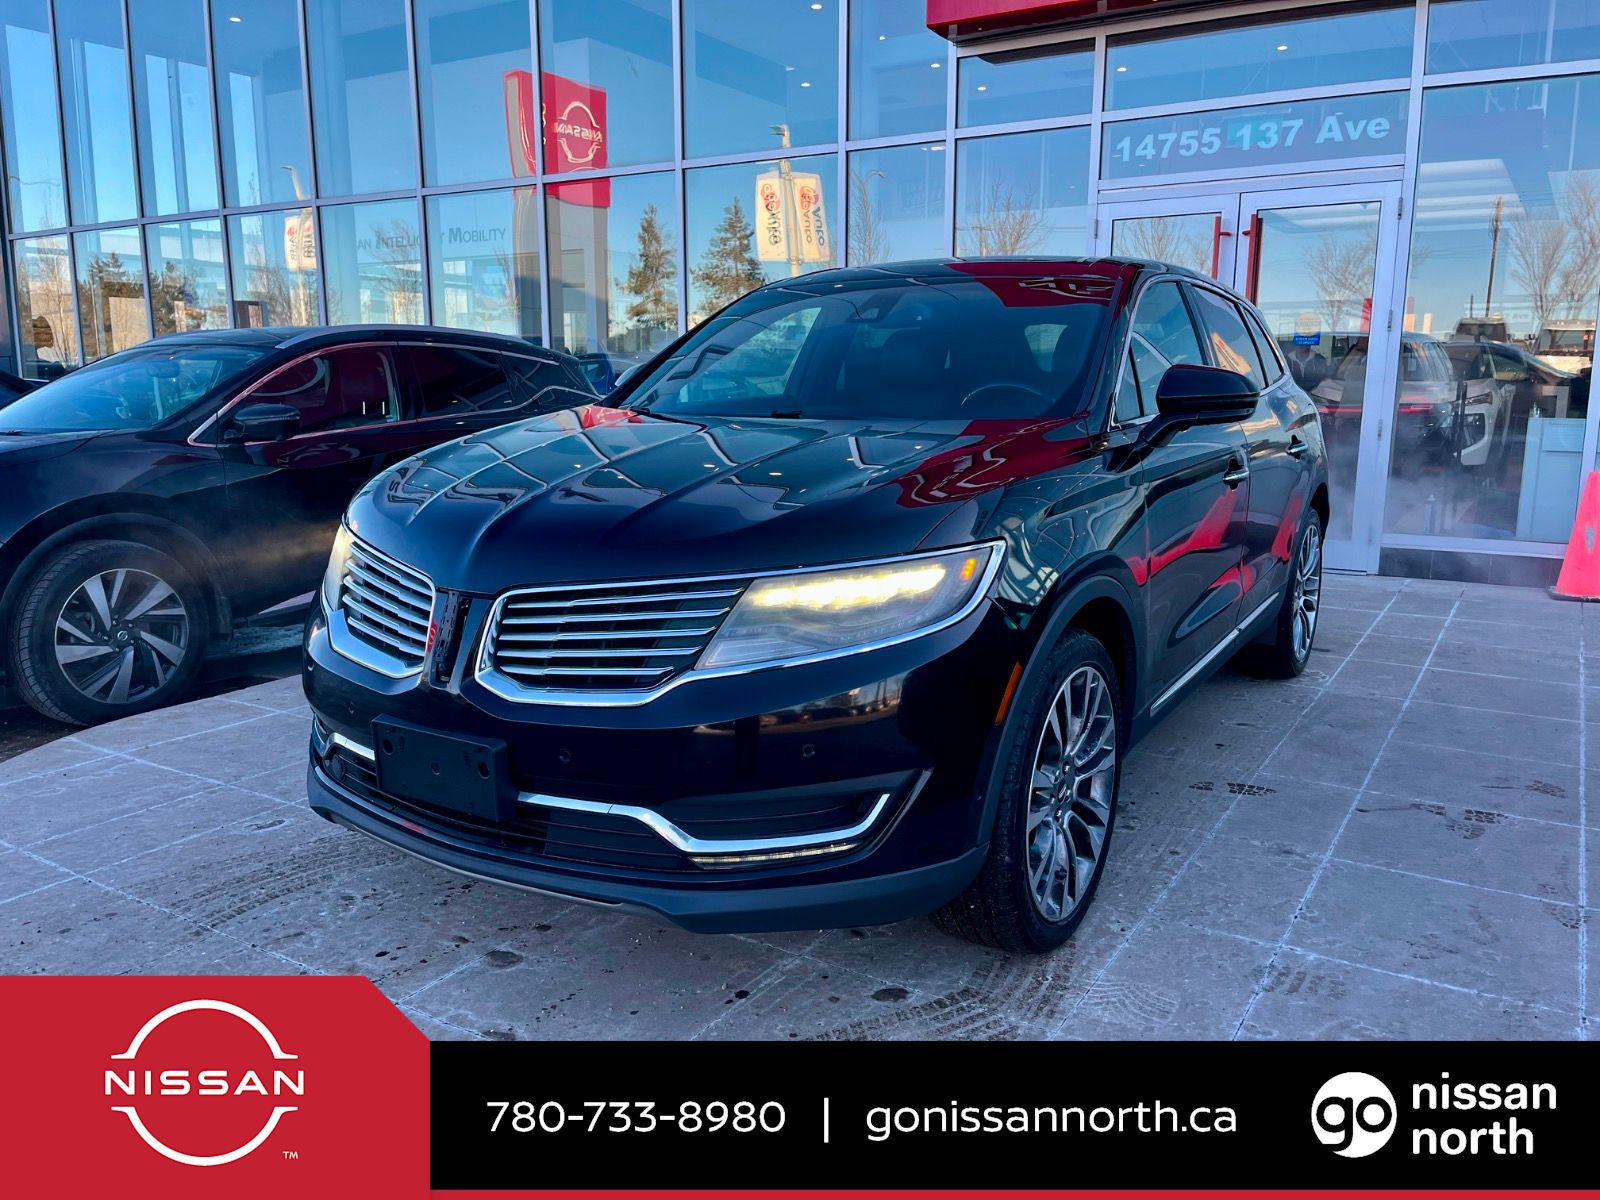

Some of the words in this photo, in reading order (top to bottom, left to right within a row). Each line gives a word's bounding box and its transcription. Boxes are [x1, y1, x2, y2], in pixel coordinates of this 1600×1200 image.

[1116, 128, 1221, 162] 14755
[1236, 119, 1304, 150] 137
[1315, 115, 1391, 144] Ave
